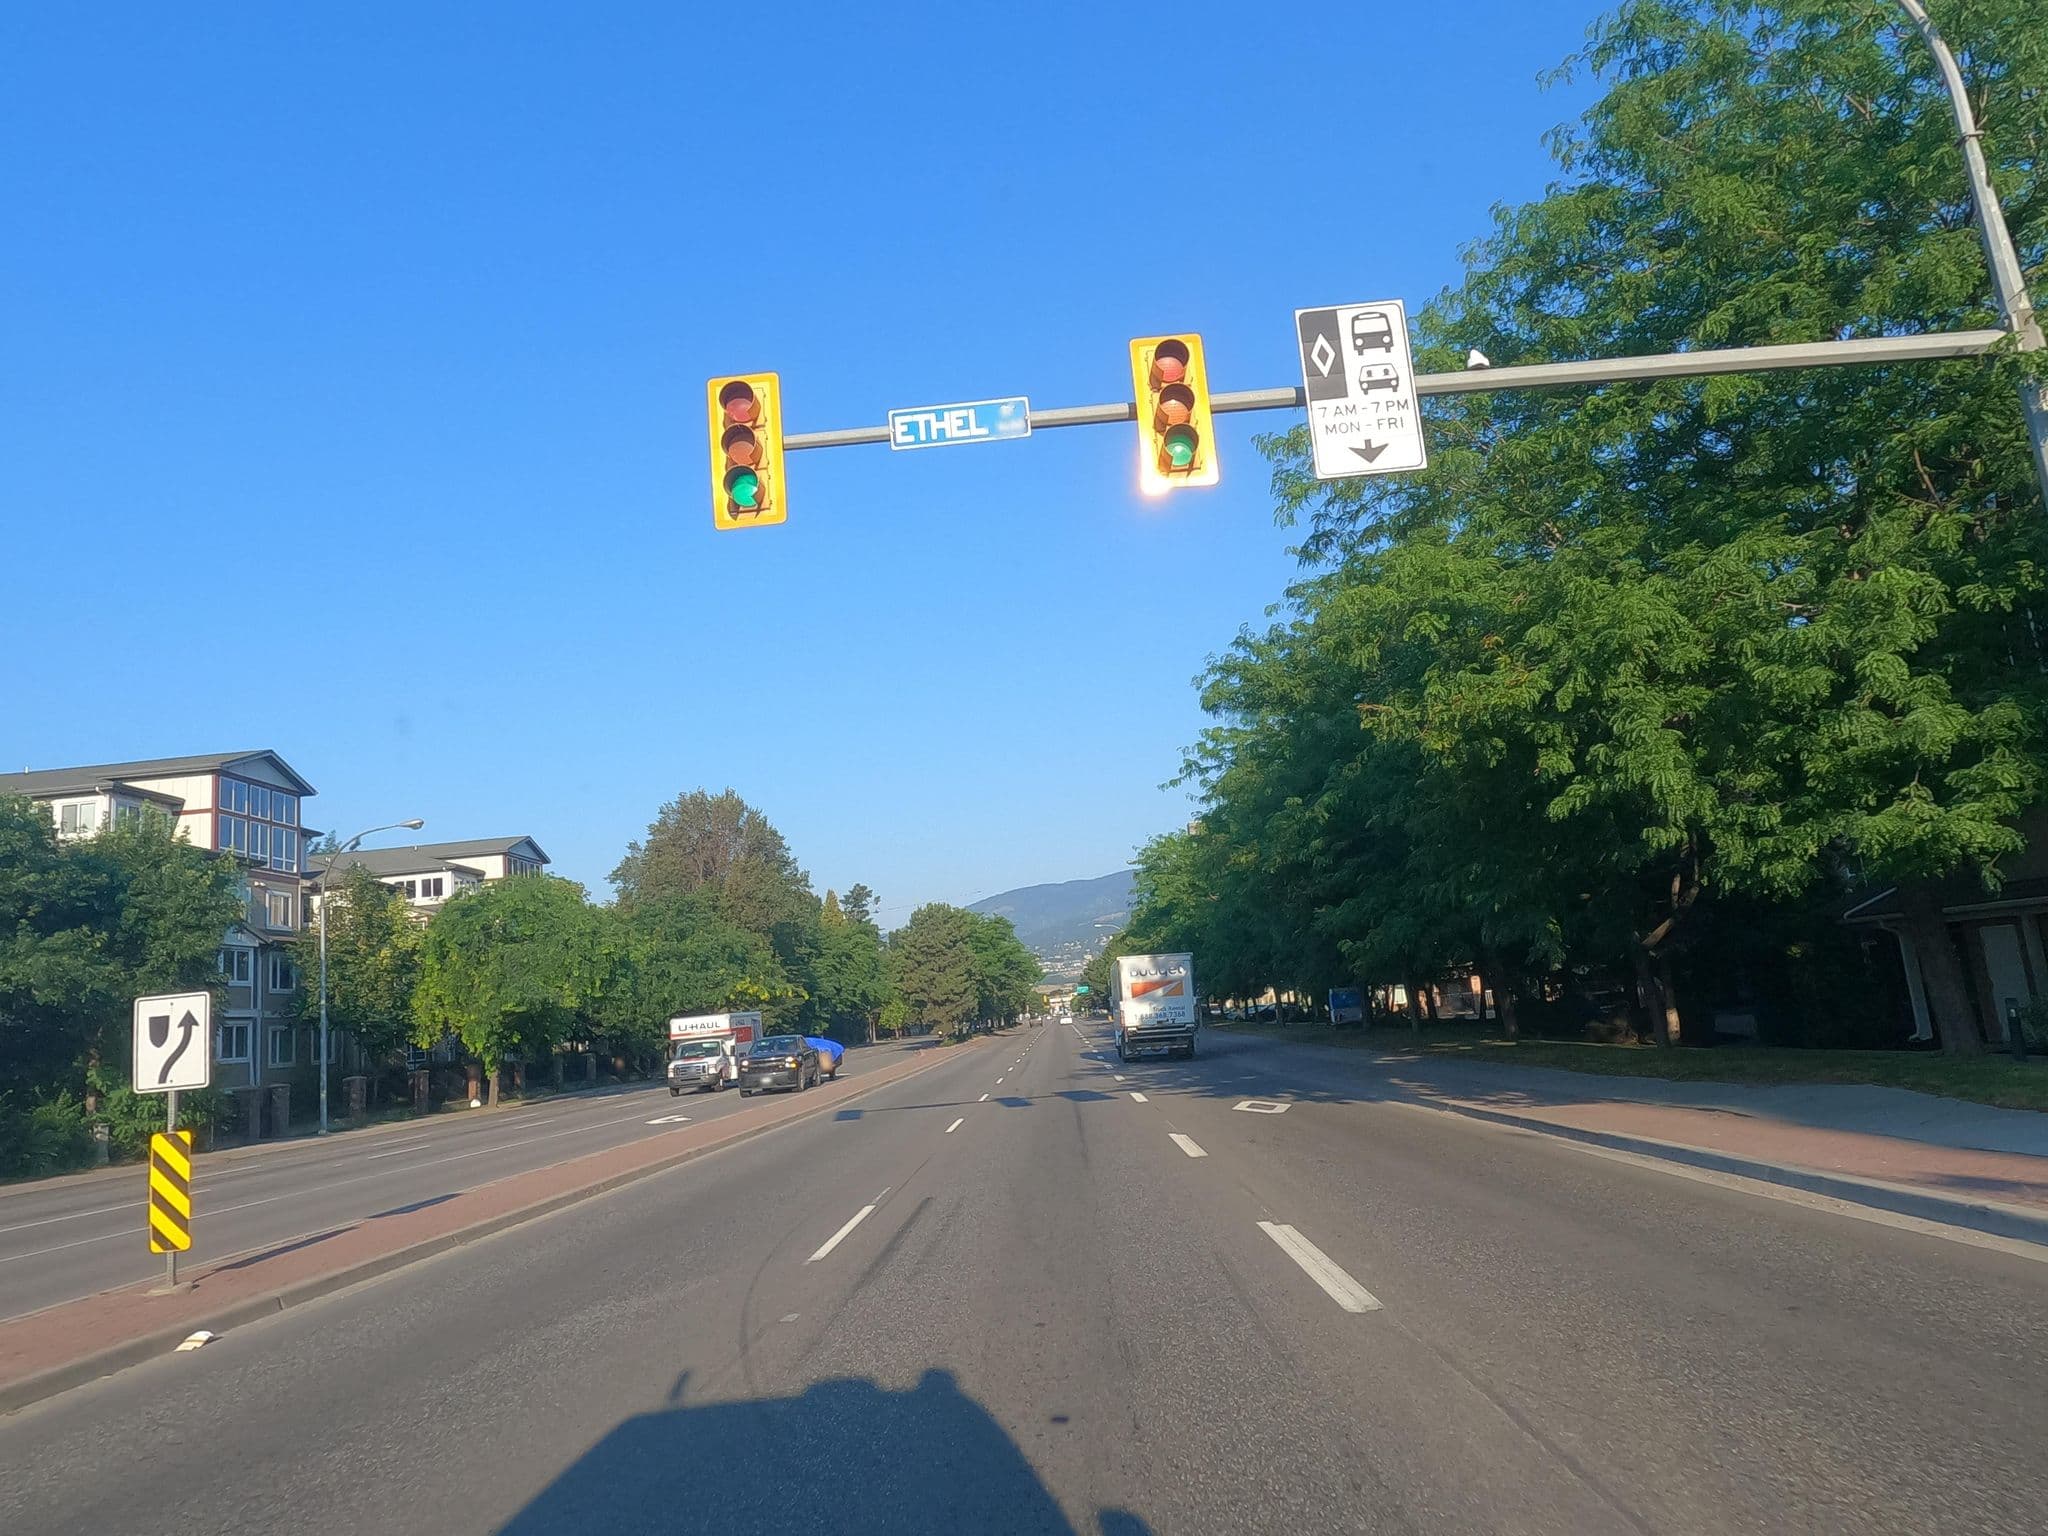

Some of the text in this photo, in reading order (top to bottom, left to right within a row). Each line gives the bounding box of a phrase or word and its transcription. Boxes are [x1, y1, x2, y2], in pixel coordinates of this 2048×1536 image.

[1318, 406, 1327, 418] 7
[1334, 403, 1357, 417] AM
[1371, 401, 1380, 414] 7
[1386, 398, 1409, 412] PM
[894, 408, 989, 443] ETHEL
[1325, 420, 1361, 435] MON
[1377, 416, 1405, 430] FRI
[678, 1021, 721, 1032] U-HAUL
